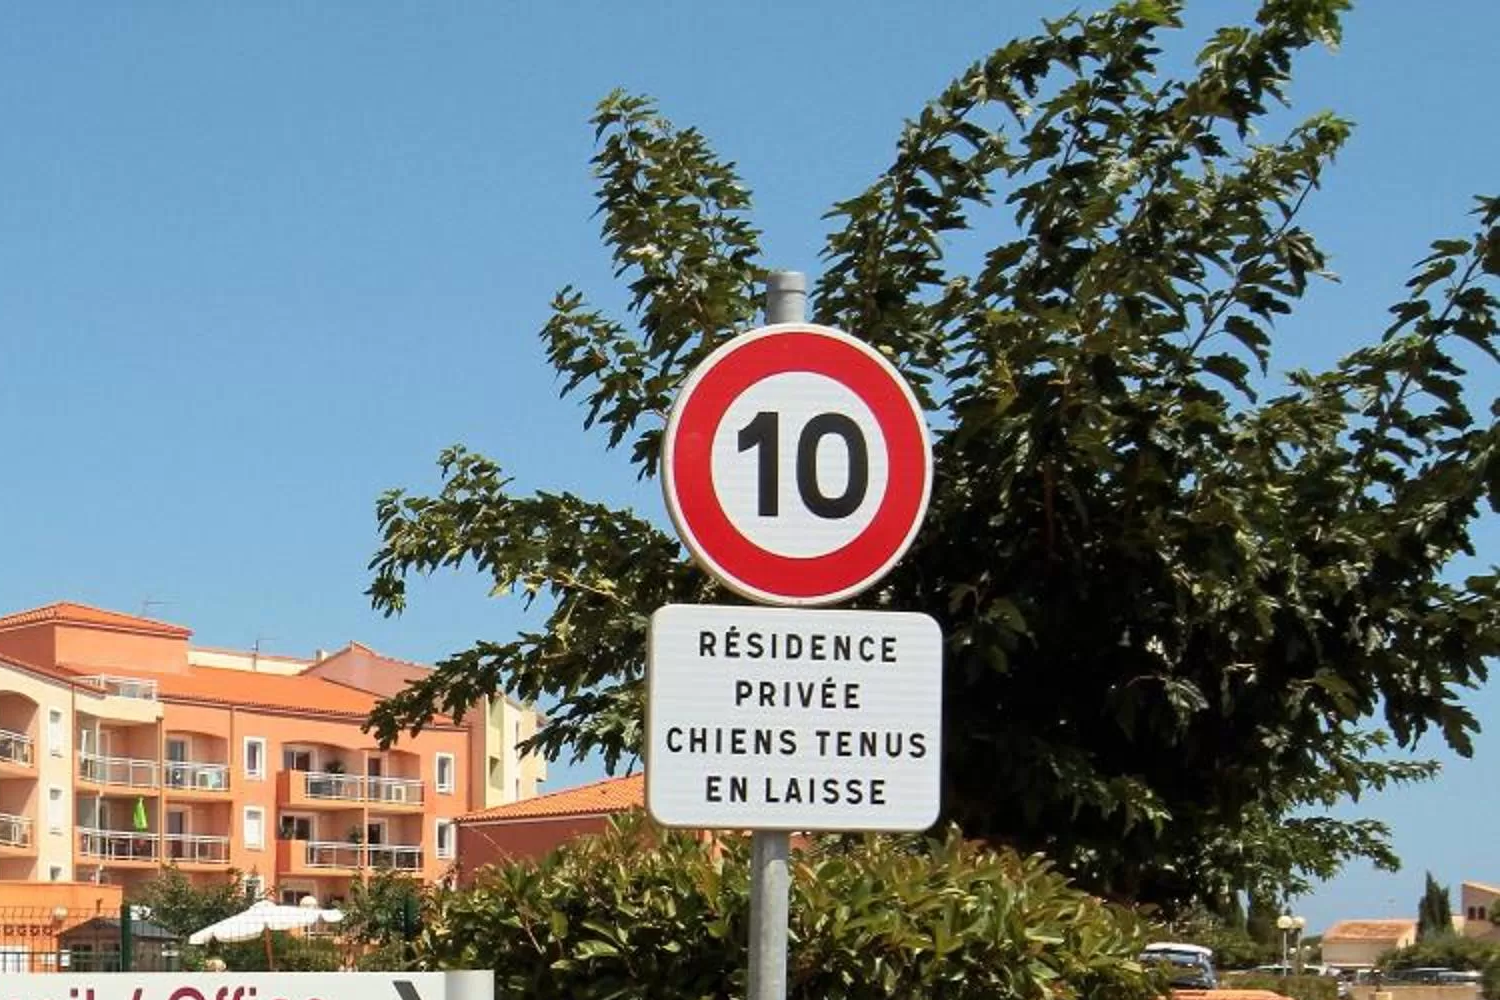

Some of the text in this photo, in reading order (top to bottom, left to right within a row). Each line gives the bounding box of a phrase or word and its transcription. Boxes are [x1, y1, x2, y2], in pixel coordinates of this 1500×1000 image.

[737, 411, 869, 520] 10
[699, 625, 897, 663] RÉSIDENCE
[735, 676, 861, 709] PRIVÉE
[666, 726, 927, 759] CHIENS TENUS
[705, 775, 886, 805] EN LAISSE
